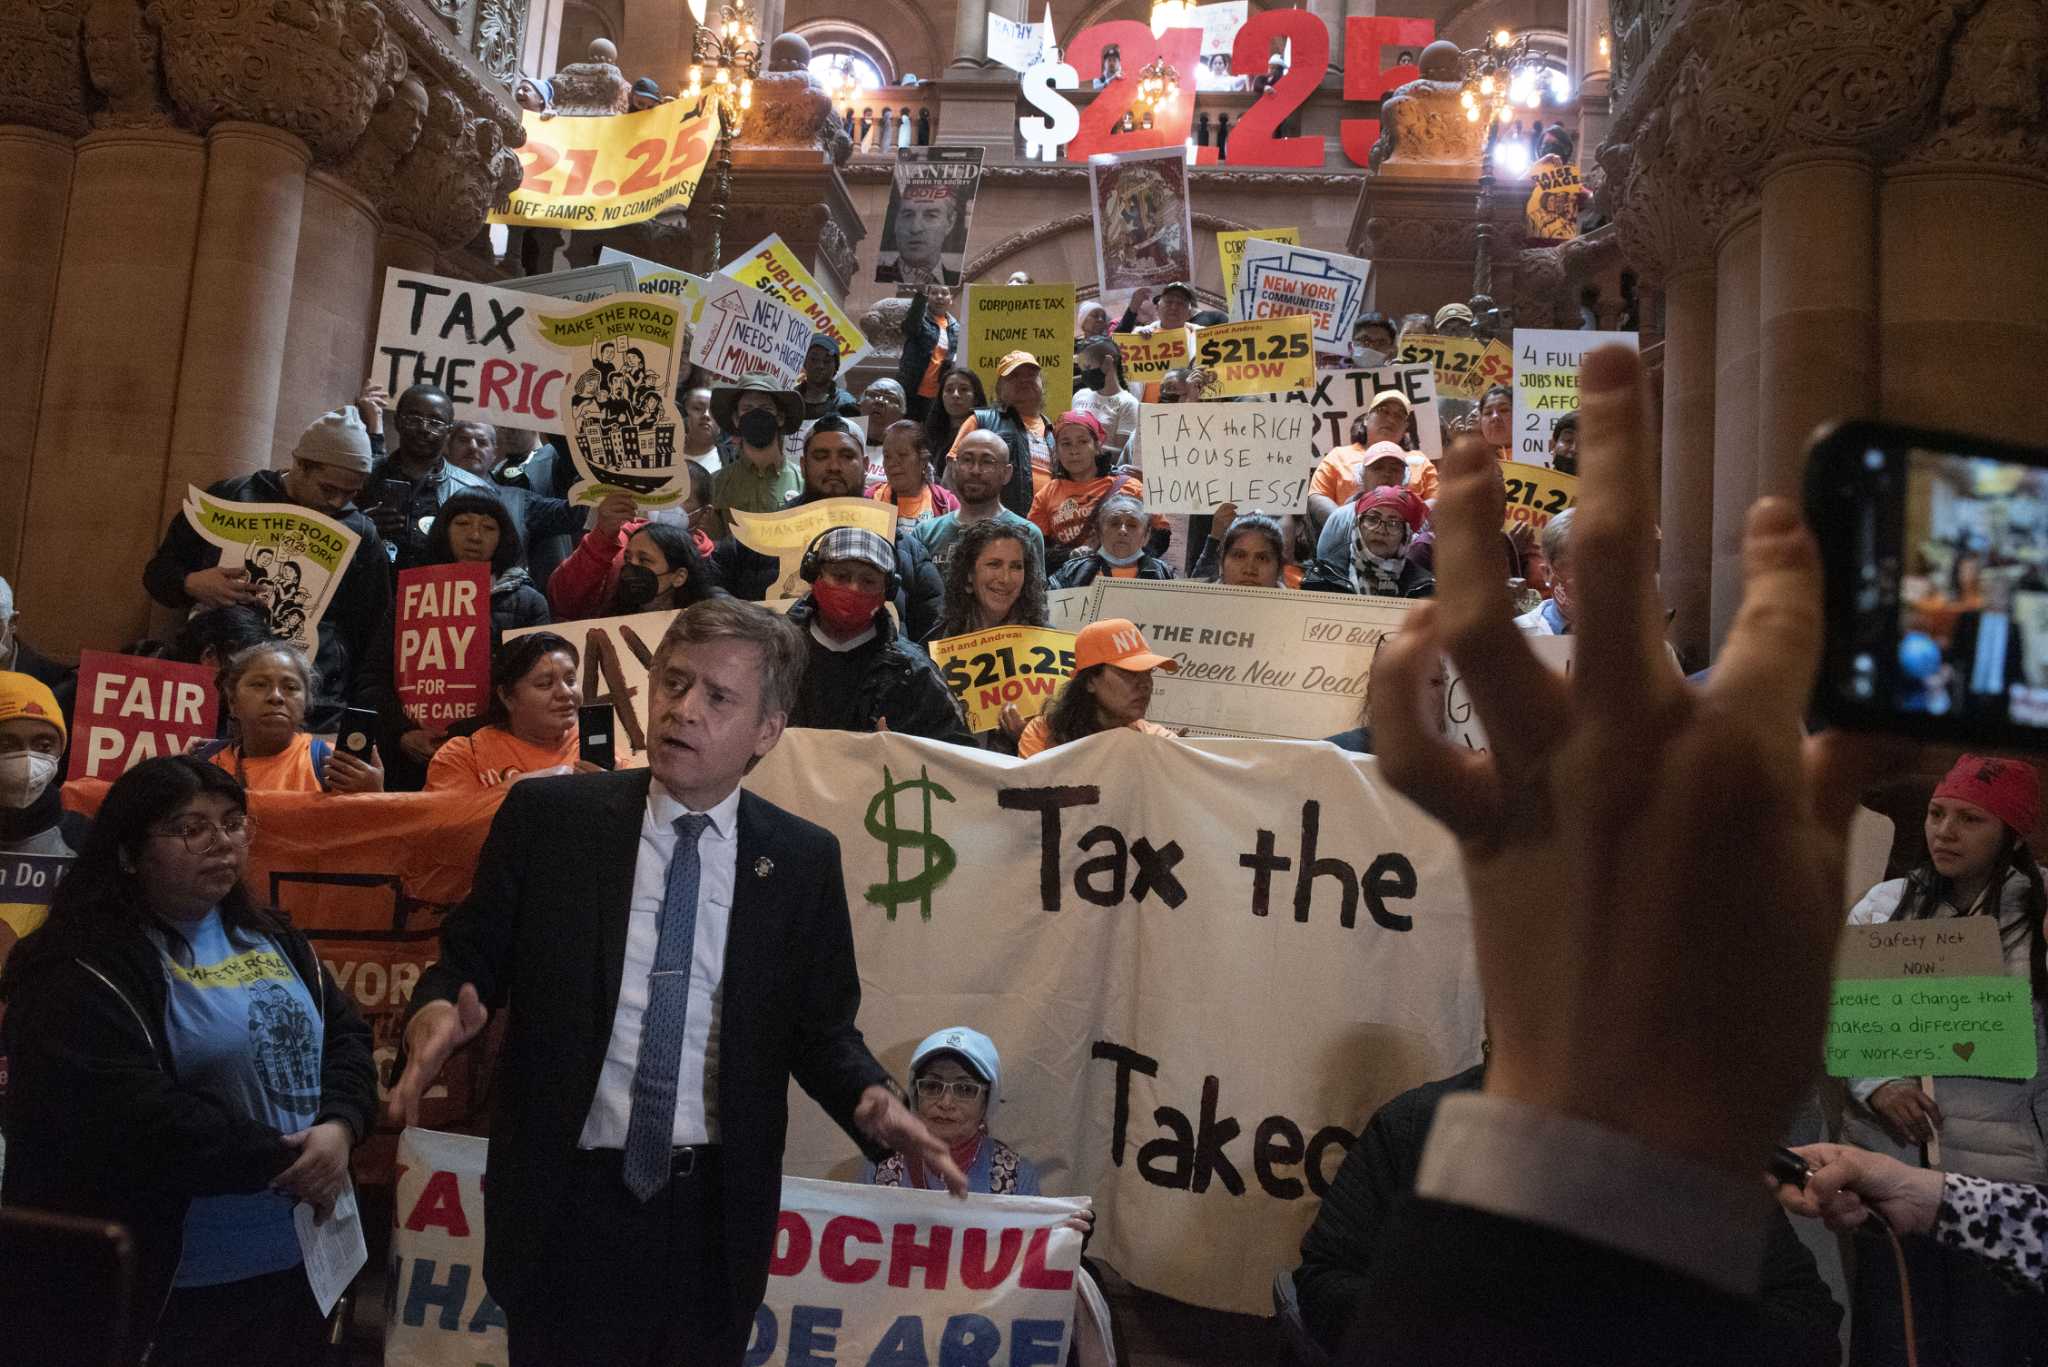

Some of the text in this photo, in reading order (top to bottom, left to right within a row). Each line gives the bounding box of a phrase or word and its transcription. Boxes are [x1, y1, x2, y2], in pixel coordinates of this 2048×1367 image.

[897, 164, 979, 179] WANTED
[1540, 175, 1580, 190] WAGE
[602, 207, 621, 221] NO
[622, 181, 696, 217] COMPROMISE
[1261, 291, 1330, 310] COMMUNITIES
[1263, 275, 1298, 293] NEW
[1300, 281, 1338, 302] YORK
[756, 249, 857, 357] PUBLIC MONEY
[979, 297, 1065, 314] CORPORATE TAX
[397, 279, 526, 354] TAX
[554, 304, 674, 335] MAKE THE ROAD
[752, 298, 784, 333] NEW
[786, 313, 812, 352] YORK
[606, 324, 671, 340] NEW YORK
[732, 321, 774, 354] NEEDS
[985, 328, 1056, 341] INCOME TAX
[1119, 340, 1186, 362] $21.25
[1201, 333, 1310, 367] $21.25
[1522, 345, 1538, 366] 4
[1134, 360, 1171, 373] NOW
[1226, 361, 1285, 381] NOW
[1435, 370, 1463, 386] OW
[380, 346, 571, 420] THE RIC
[1345, 368, 1431, 408] THE
[1519, 374, 1551, 388] JOBS
[1150, 413, 1215, 442] TAX
[1223, 418, 1248, 438] the
[1252, 412, 1302, 441] RICH
[1525, 413, 1540, 432] 2
[1161, 446, 1293, 468] HOUSE the
[1522, 438, 1544, 452] ON
[1146, 476, 1307, 508] HOMELESS!
[211, 512, 343, 553] MAKE THE ROAD
[308, 542, 337, 564] ORK
[404, 580, 477, 621] FAIR
[1153, 625, 1194, 643] THE
[1198, 629, 1255, 649] RICH
[1308, 622, 1342, 642] $10
[400, 626, 477, 673] PAY
[957, 639, 978, 651] and
[942, 646, 1077, 697] $21.25
[1241, 660, 1297, 688] New
[1301, 665, 1369, 695] Deal
[93, 671, 206, 725] FAIR
[416, 678, 446, 695] FOR
[979, 676, 1057, 710] NOW
[431, 702, 477, 719] CARE
[85, 726, 202, 777] PAY
[998, 784, 1188, 913] Tax
[1239, 799, 1418, 932] the
[16, 863, 46, 888] Do
[1936, 932, 1965, 946] Net
[323, 959, 438, 1007] YOR
[1894, 995, 1904, 1005] a
[1978, 991, 2014, 1004] that
[1890, 1023, 1901, 1033] a
